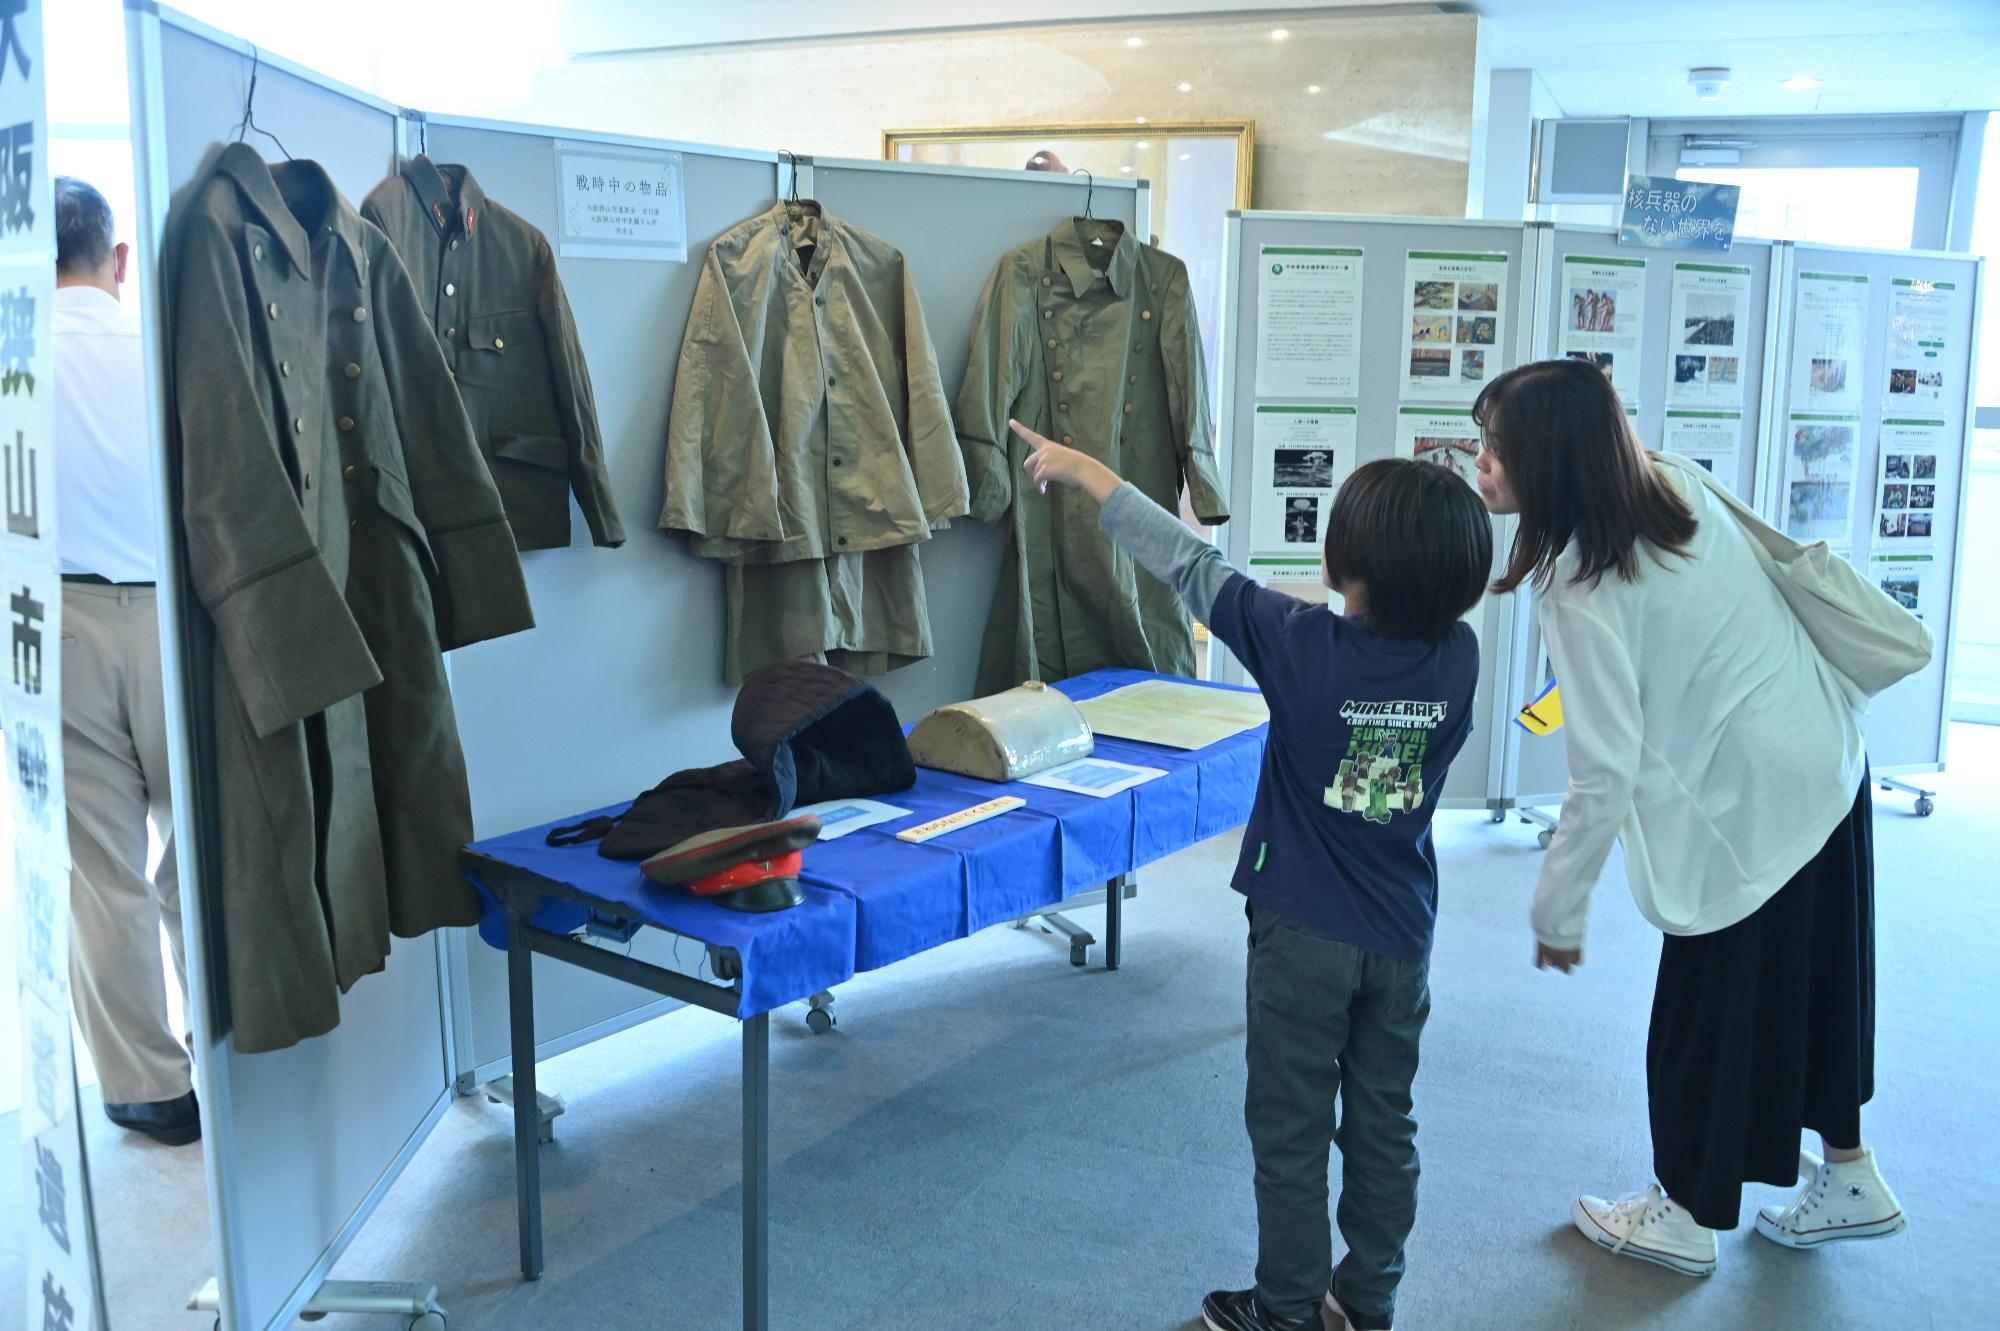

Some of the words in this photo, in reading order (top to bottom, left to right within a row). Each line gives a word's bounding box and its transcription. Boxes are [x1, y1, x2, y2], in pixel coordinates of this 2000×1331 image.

[575, 174, 668, 197] 戦時中の物品
[1627, 188, 1697, 212] 核兵器の
[1642, 216, 1726, 240] ない世界を
[1340, 700, 1447, 722] MINECRAFT
[1387, 720, 1412, 728] SINCE
[1413, 721, 1438, 729] ALPHA
